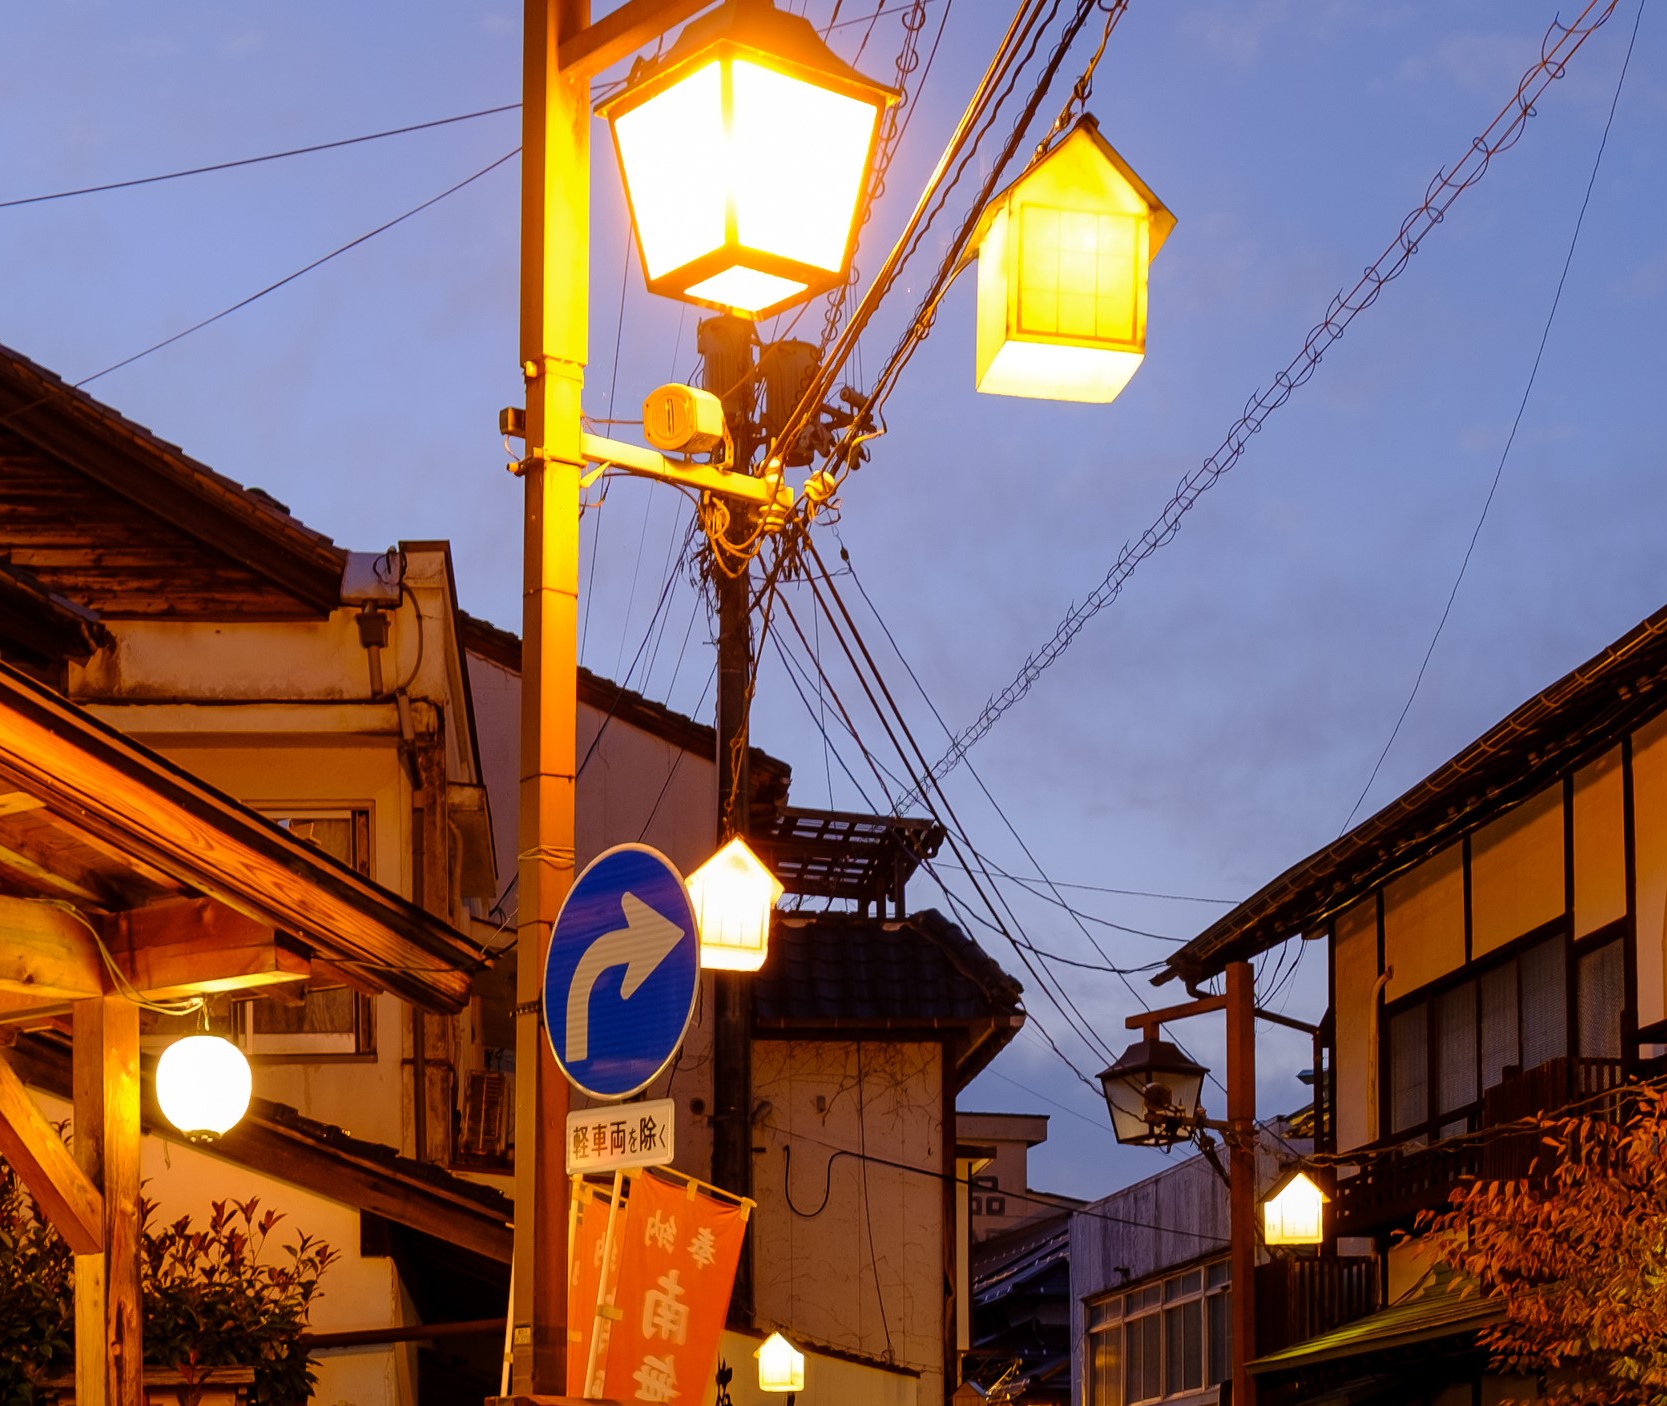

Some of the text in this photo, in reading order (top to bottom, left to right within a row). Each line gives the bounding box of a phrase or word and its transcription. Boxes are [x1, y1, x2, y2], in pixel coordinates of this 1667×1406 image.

[573, 1115, 666, 1161] 軽車両を除く
